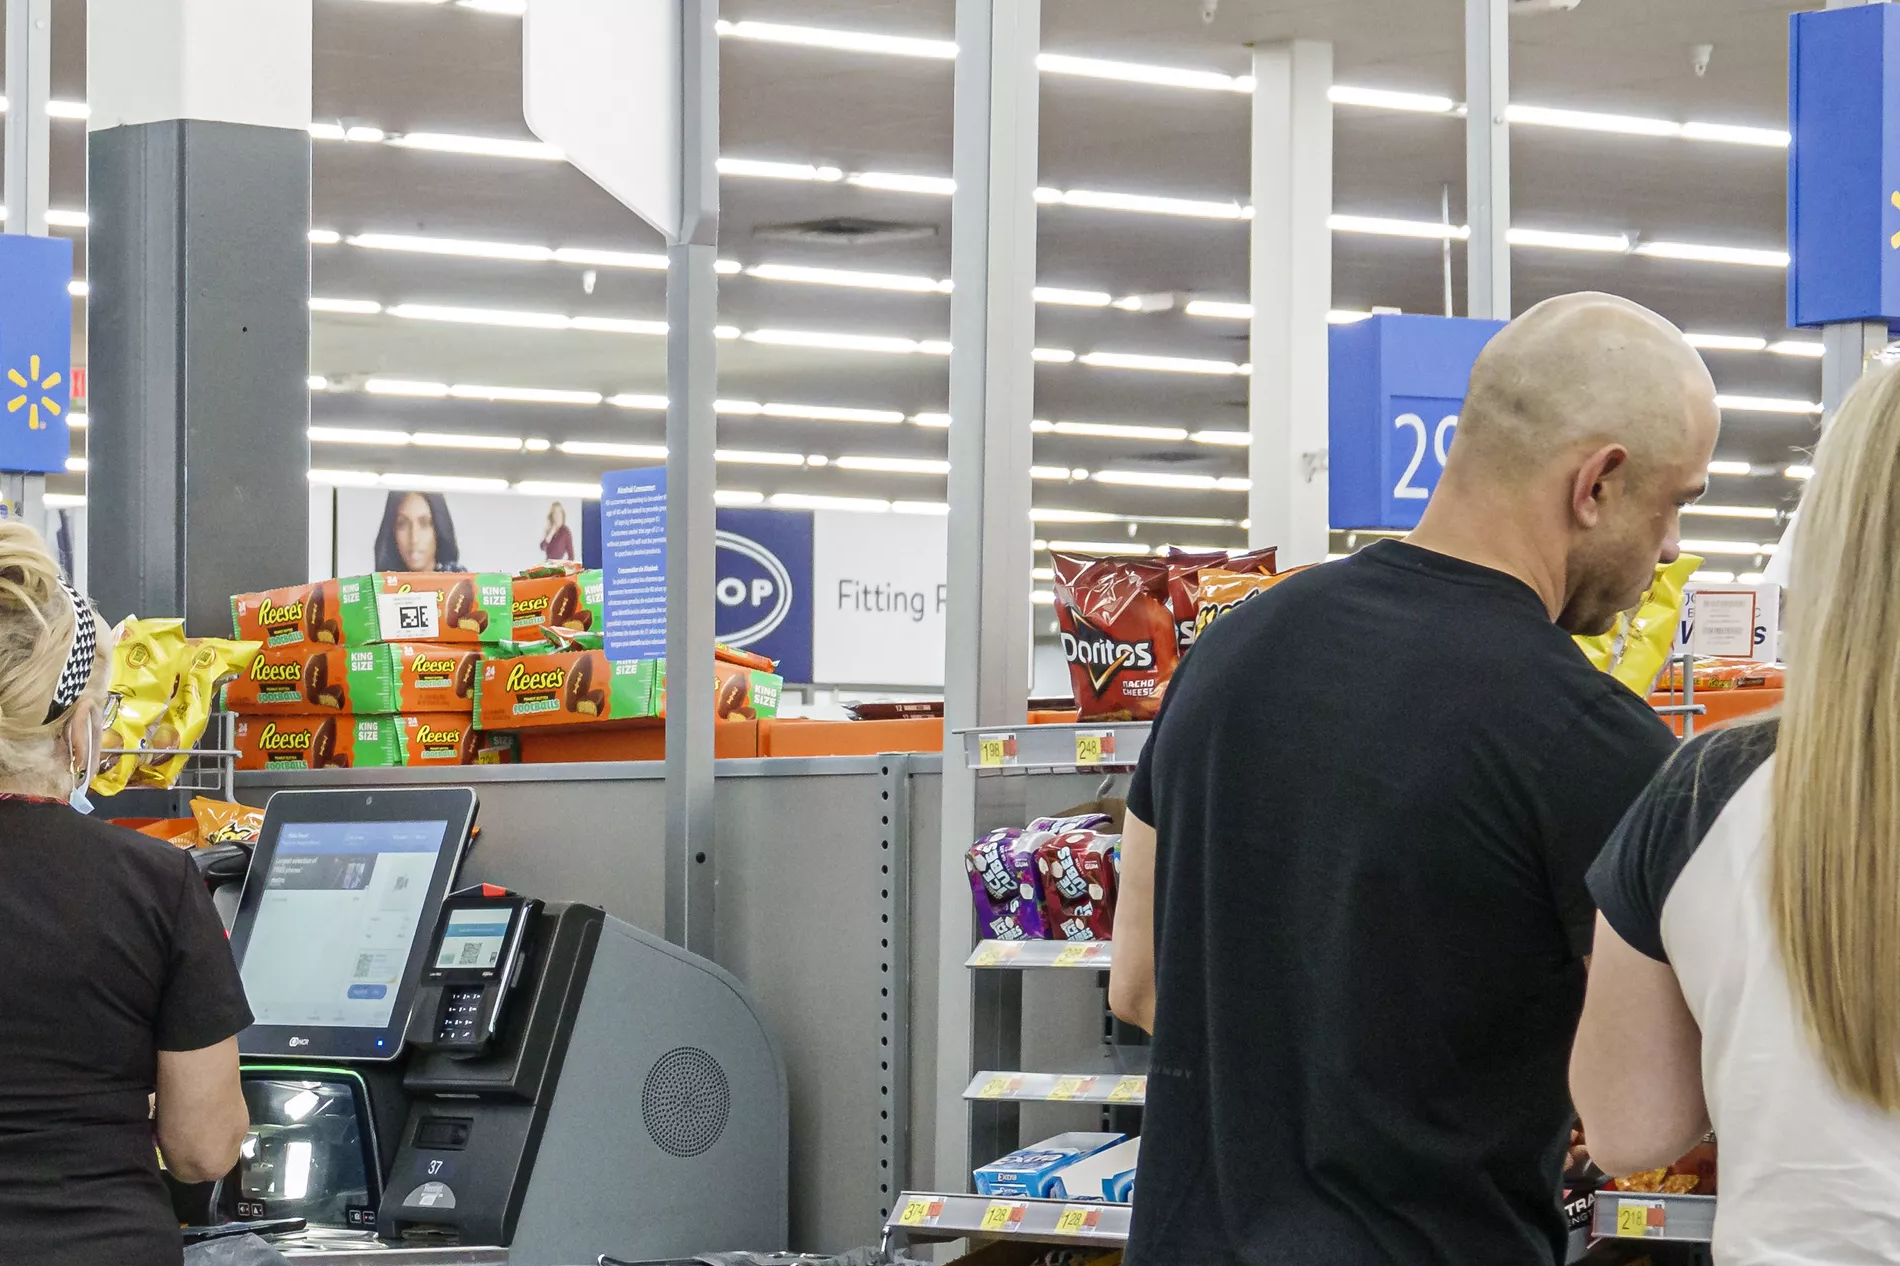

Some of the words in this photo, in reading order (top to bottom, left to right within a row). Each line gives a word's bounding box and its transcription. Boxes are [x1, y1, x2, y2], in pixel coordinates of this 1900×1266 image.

[342, 583, 359, 594] KING
[482, 586, 506, 597] KING
[717, 577, 773, 607] OP
[343, 593, 360, 604] SIZE
[482, 596, 506, 606] SIZE
[838, 579, 925, 621] Fitting
[258, 598, 304, 626] Reese's
[1060, 632, 1153, 667] Doritos
[351, 652, 373, 662] KING
[411, 653, 455, 673] Reese's
[250, 654, 302, 681] Reese's
[351, 661, 374, 671] SIZE
[616, 664, 638, 675] SIZE
[506, 662, 565, 691] Reese's
[755, 685, 778, 698] KING
[1122, 687, 1155, 696] CHEESE
[754, 695, 776, 708] SIZE
[358, 722, 378, 732] KING
[259, 722, 311, 750] Reese's
[358, 731, 378, 741] SIZE
[416, 724, 460, 744] Reese's
[493, 735, 513, 746] SIZE
[428, 1160, 443, 1174] 37
[997, 1172, 1017, 1182] Extra
[1564, 1190, 1596, 1213] TRA
[903, 1203, 925, 1221] 374
[986, 1207, 1006, 1224] 128
[1062, 1211, 1083, 1227] 128
